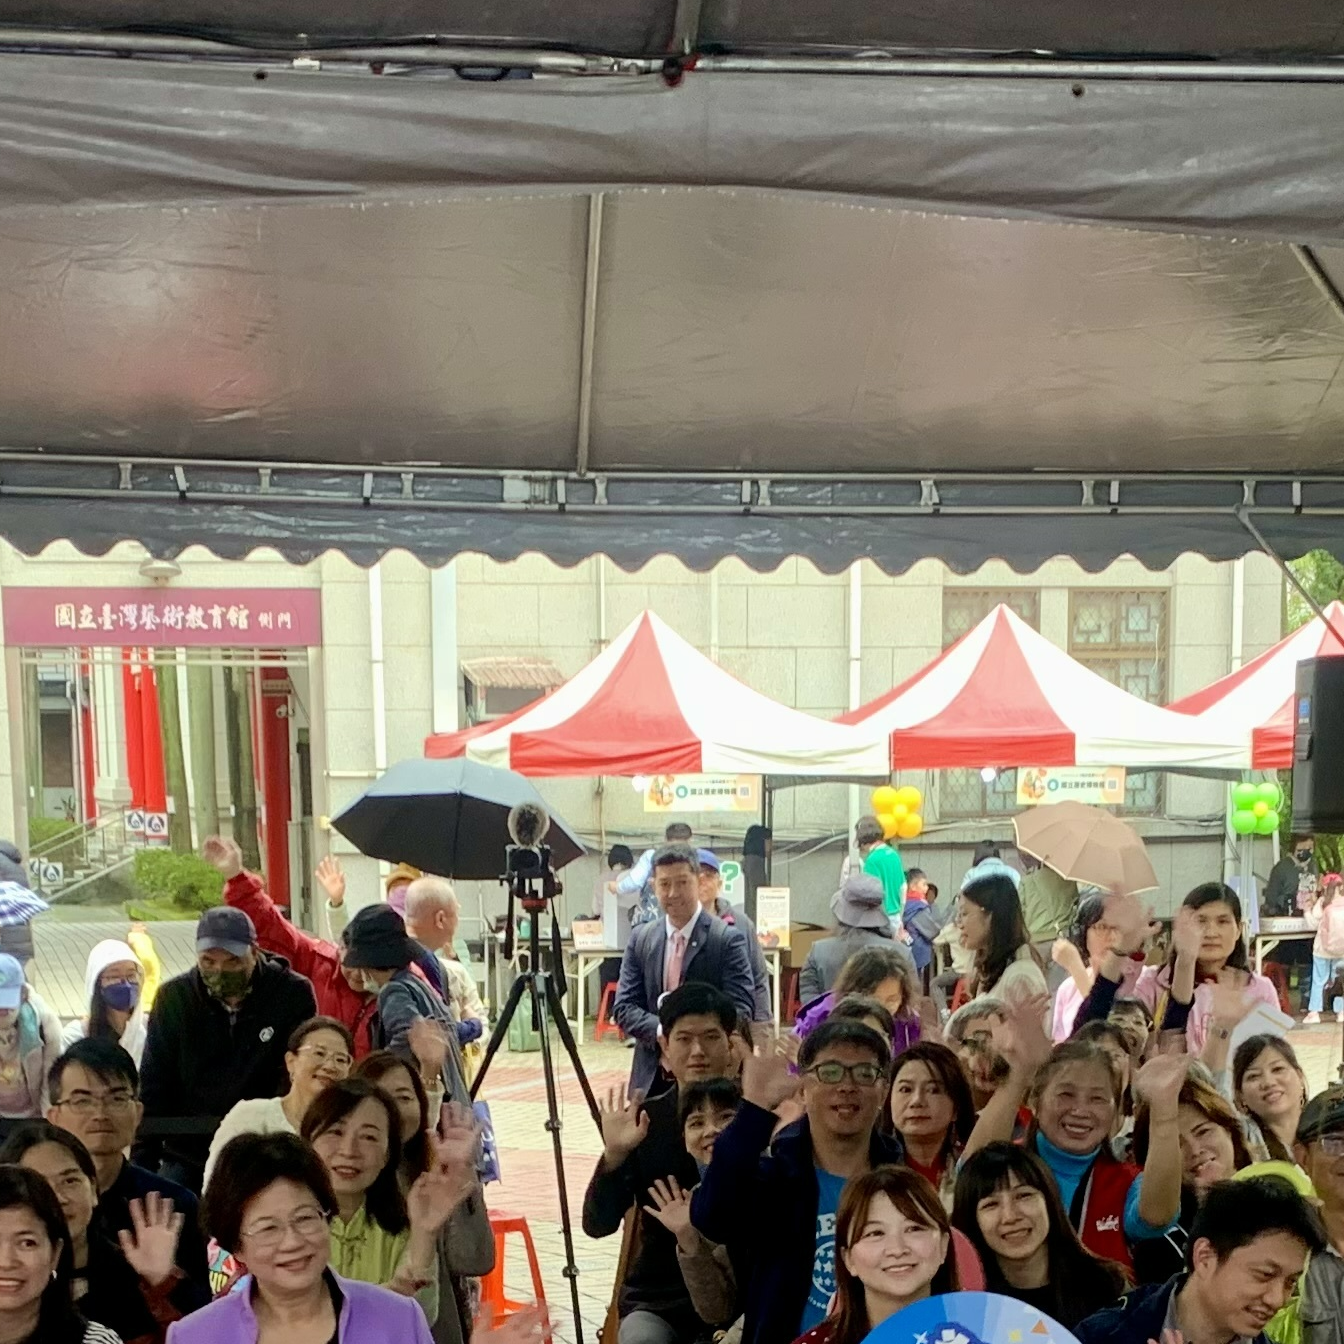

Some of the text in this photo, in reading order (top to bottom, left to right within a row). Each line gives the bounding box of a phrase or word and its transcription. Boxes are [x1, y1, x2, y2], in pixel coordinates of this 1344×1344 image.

[54, 603, 292, 631] 國立臺灣藝術教育館 側門
